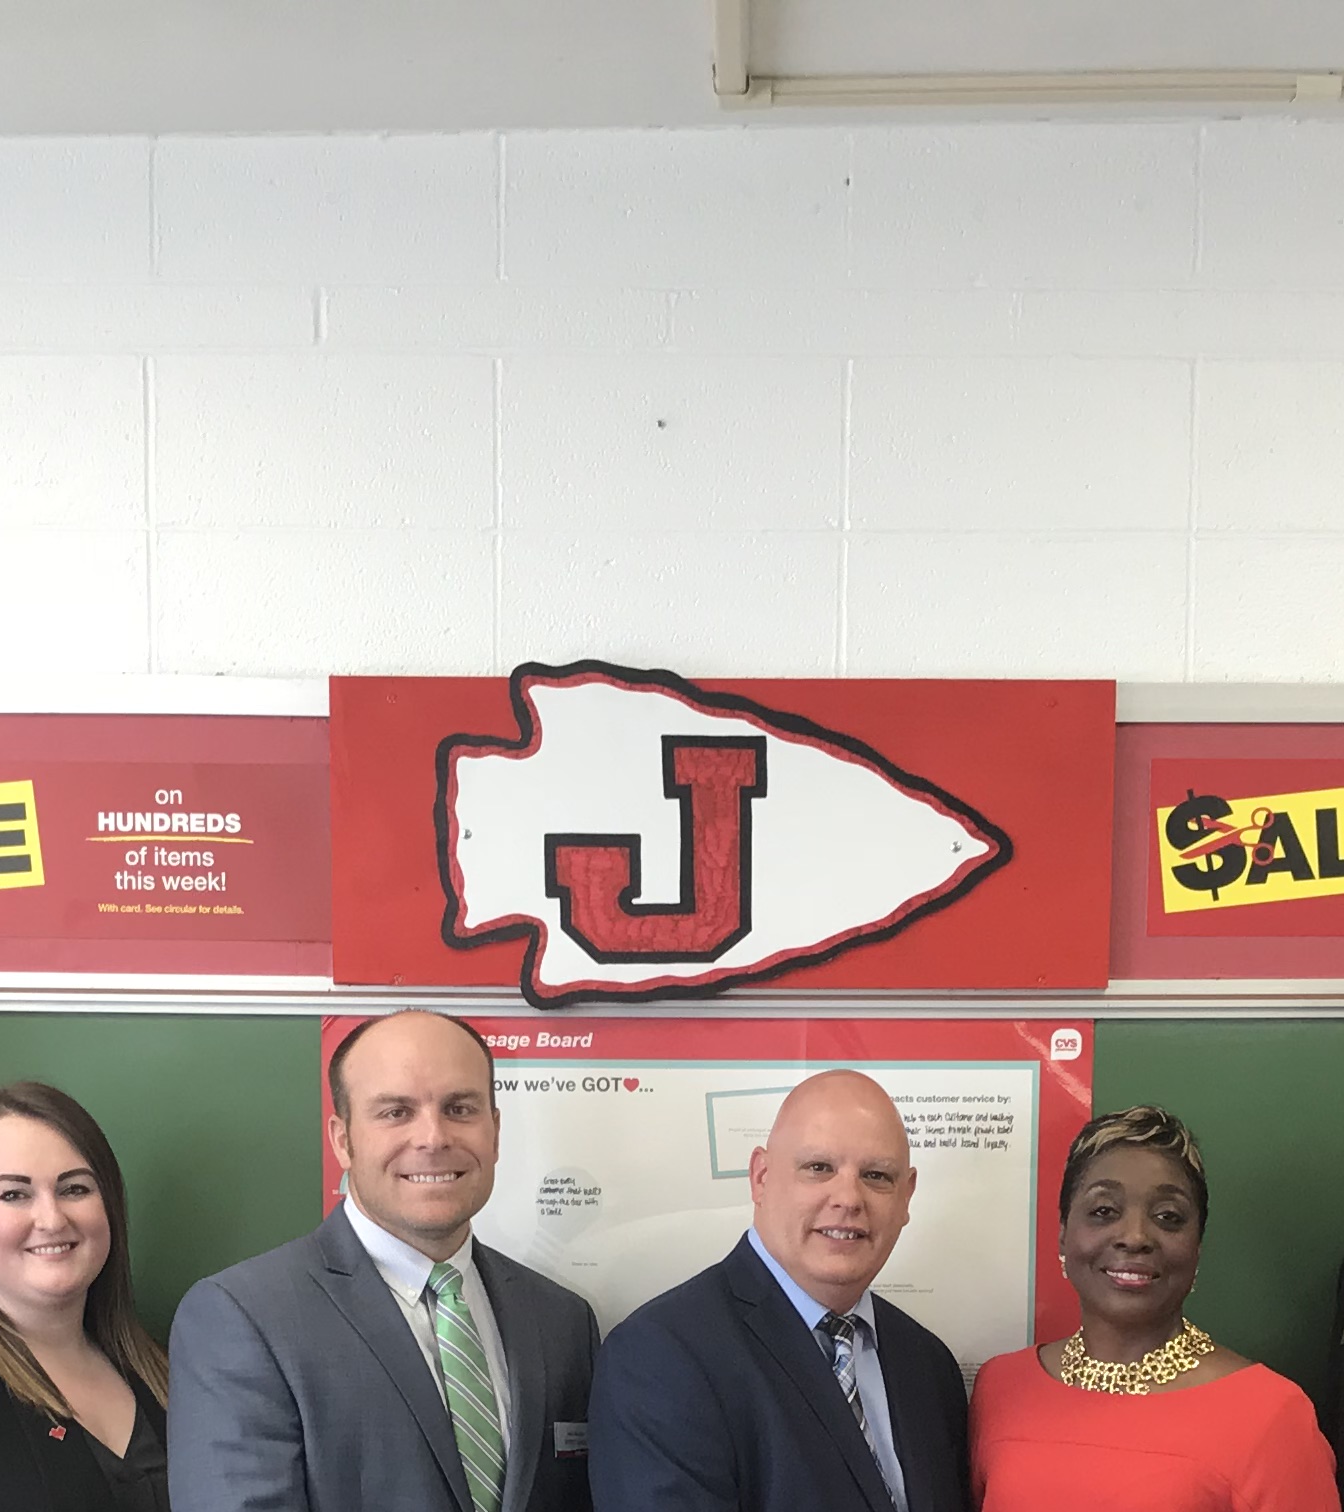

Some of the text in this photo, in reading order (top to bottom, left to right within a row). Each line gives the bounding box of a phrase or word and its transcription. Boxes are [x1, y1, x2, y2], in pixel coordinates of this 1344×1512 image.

[154, 789, 183, 805] on
[98, 812, 241, 833] HUNDREDS
[125, 846, 215, 867] of items
[545, 735, 767, 963] J
[114, 870, 226, 892] this week!
[97, 903, 245, 915] With card. See circular for details.
[536, 1032, 594, 1048] Board
[1055, 1038, 1078, 1048] CVS
[524, 1077, 576, 1092] we've
[916, 1095, 960, 1103] customer
[962, 1095, 995, 1103] service
